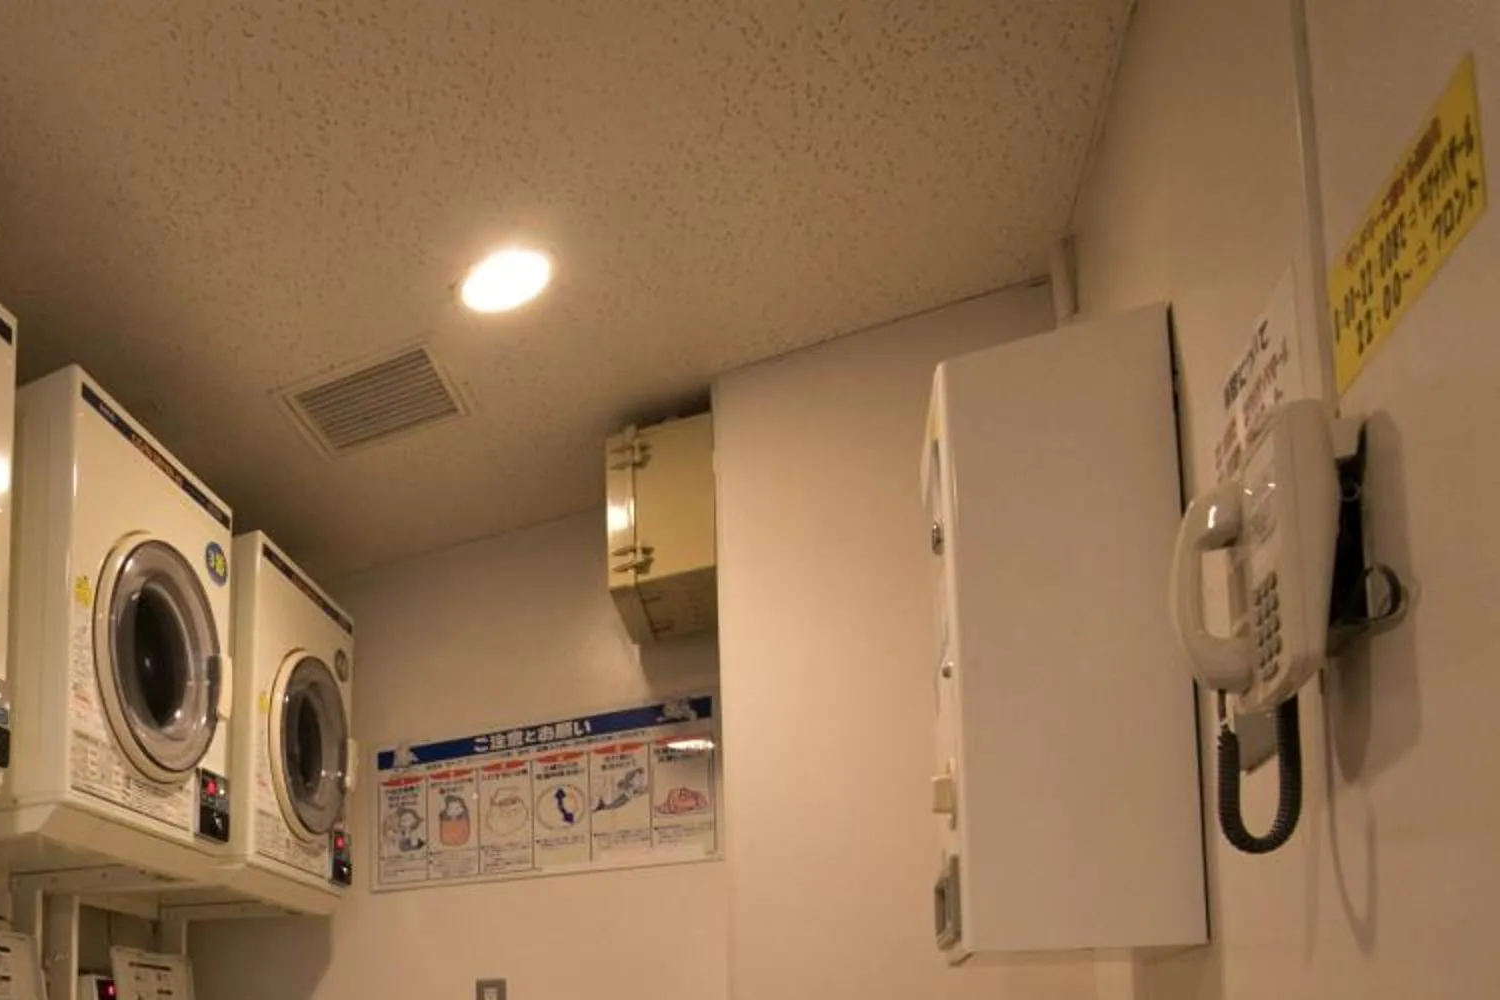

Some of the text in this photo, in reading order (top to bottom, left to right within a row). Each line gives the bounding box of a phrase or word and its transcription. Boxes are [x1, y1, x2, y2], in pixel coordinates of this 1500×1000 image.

[473, 719, 592, 752] ご注意とお願い
